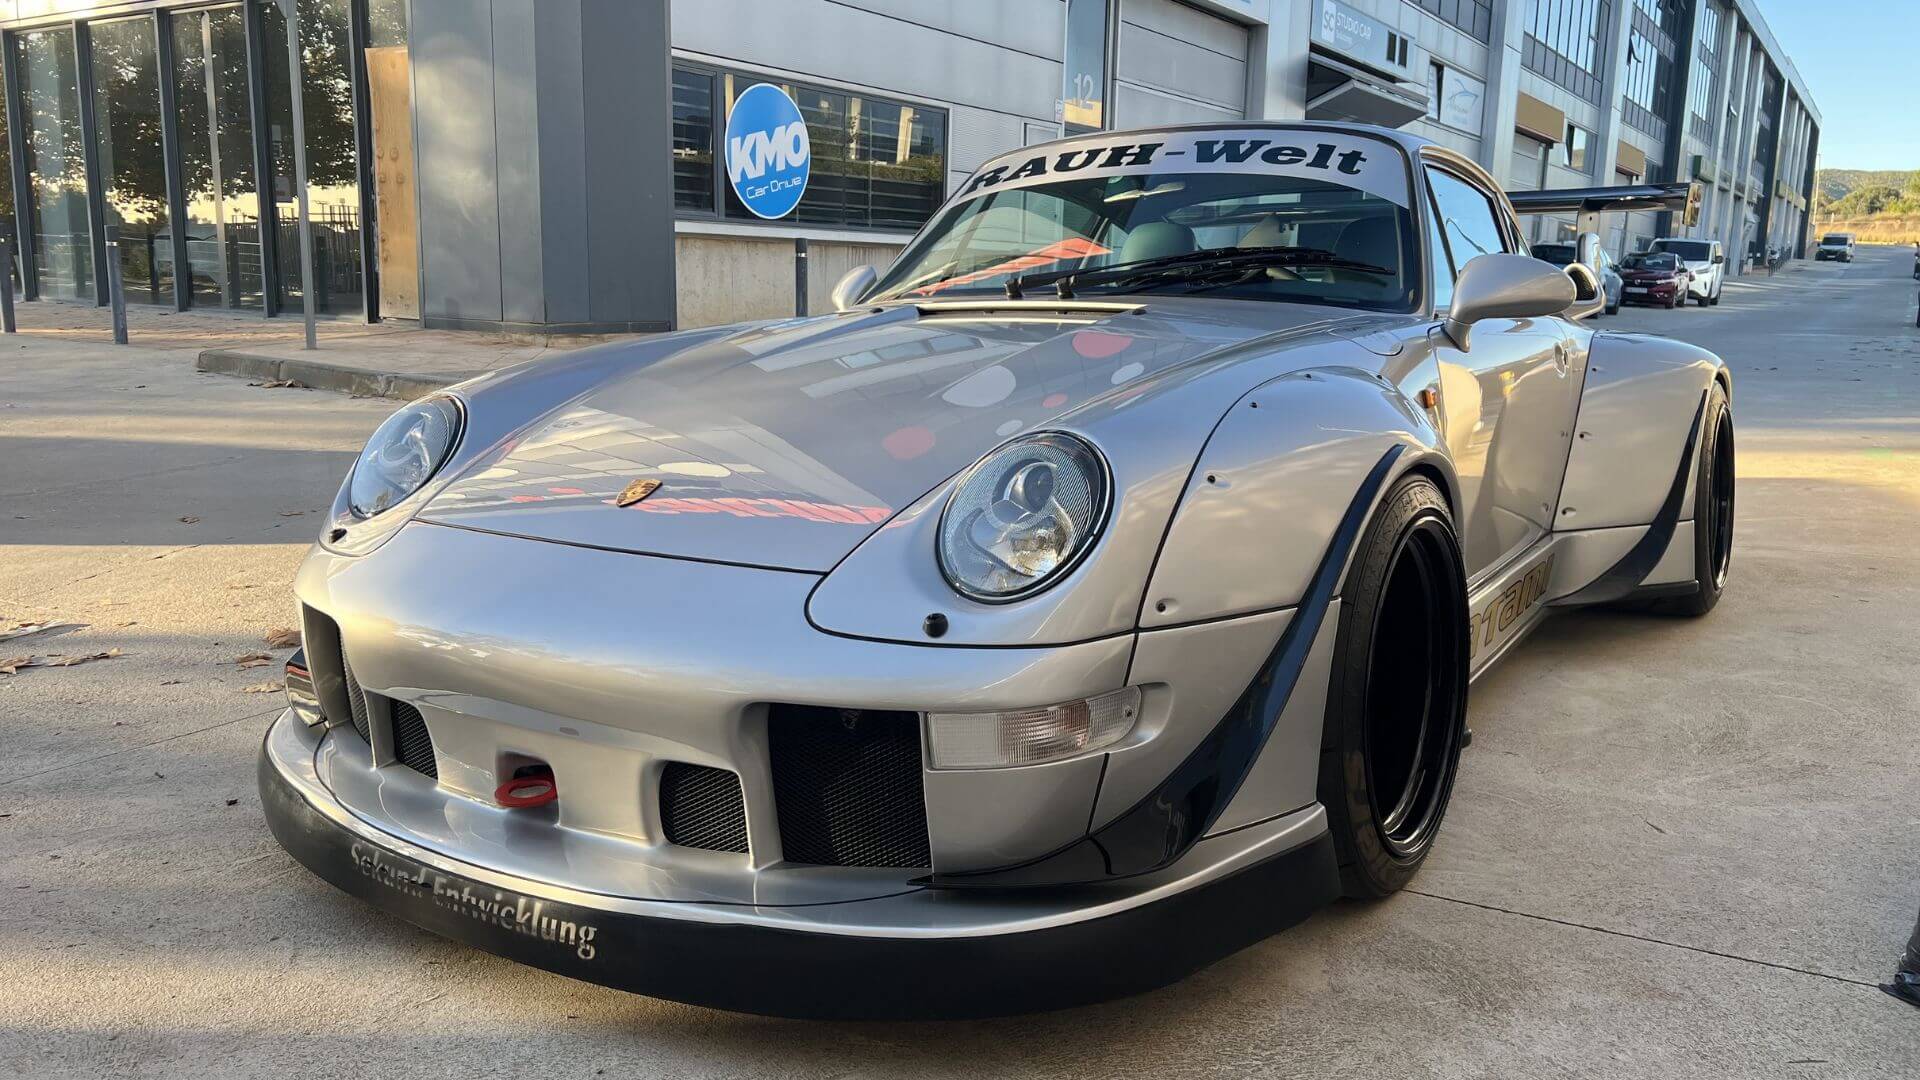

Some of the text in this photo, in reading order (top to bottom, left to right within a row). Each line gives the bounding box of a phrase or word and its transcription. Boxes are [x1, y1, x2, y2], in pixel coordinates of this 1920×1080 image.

[1336, 12, 1359, 35] STUDIO
[1359, 23, 1371, 40] CAR
[1073, 73, 1093, 110] 12
[731, 121, 808, 183] KMO
[746, 177, 801, 199] Car Drive
[433, 875, 598, 960] Entwicklung
